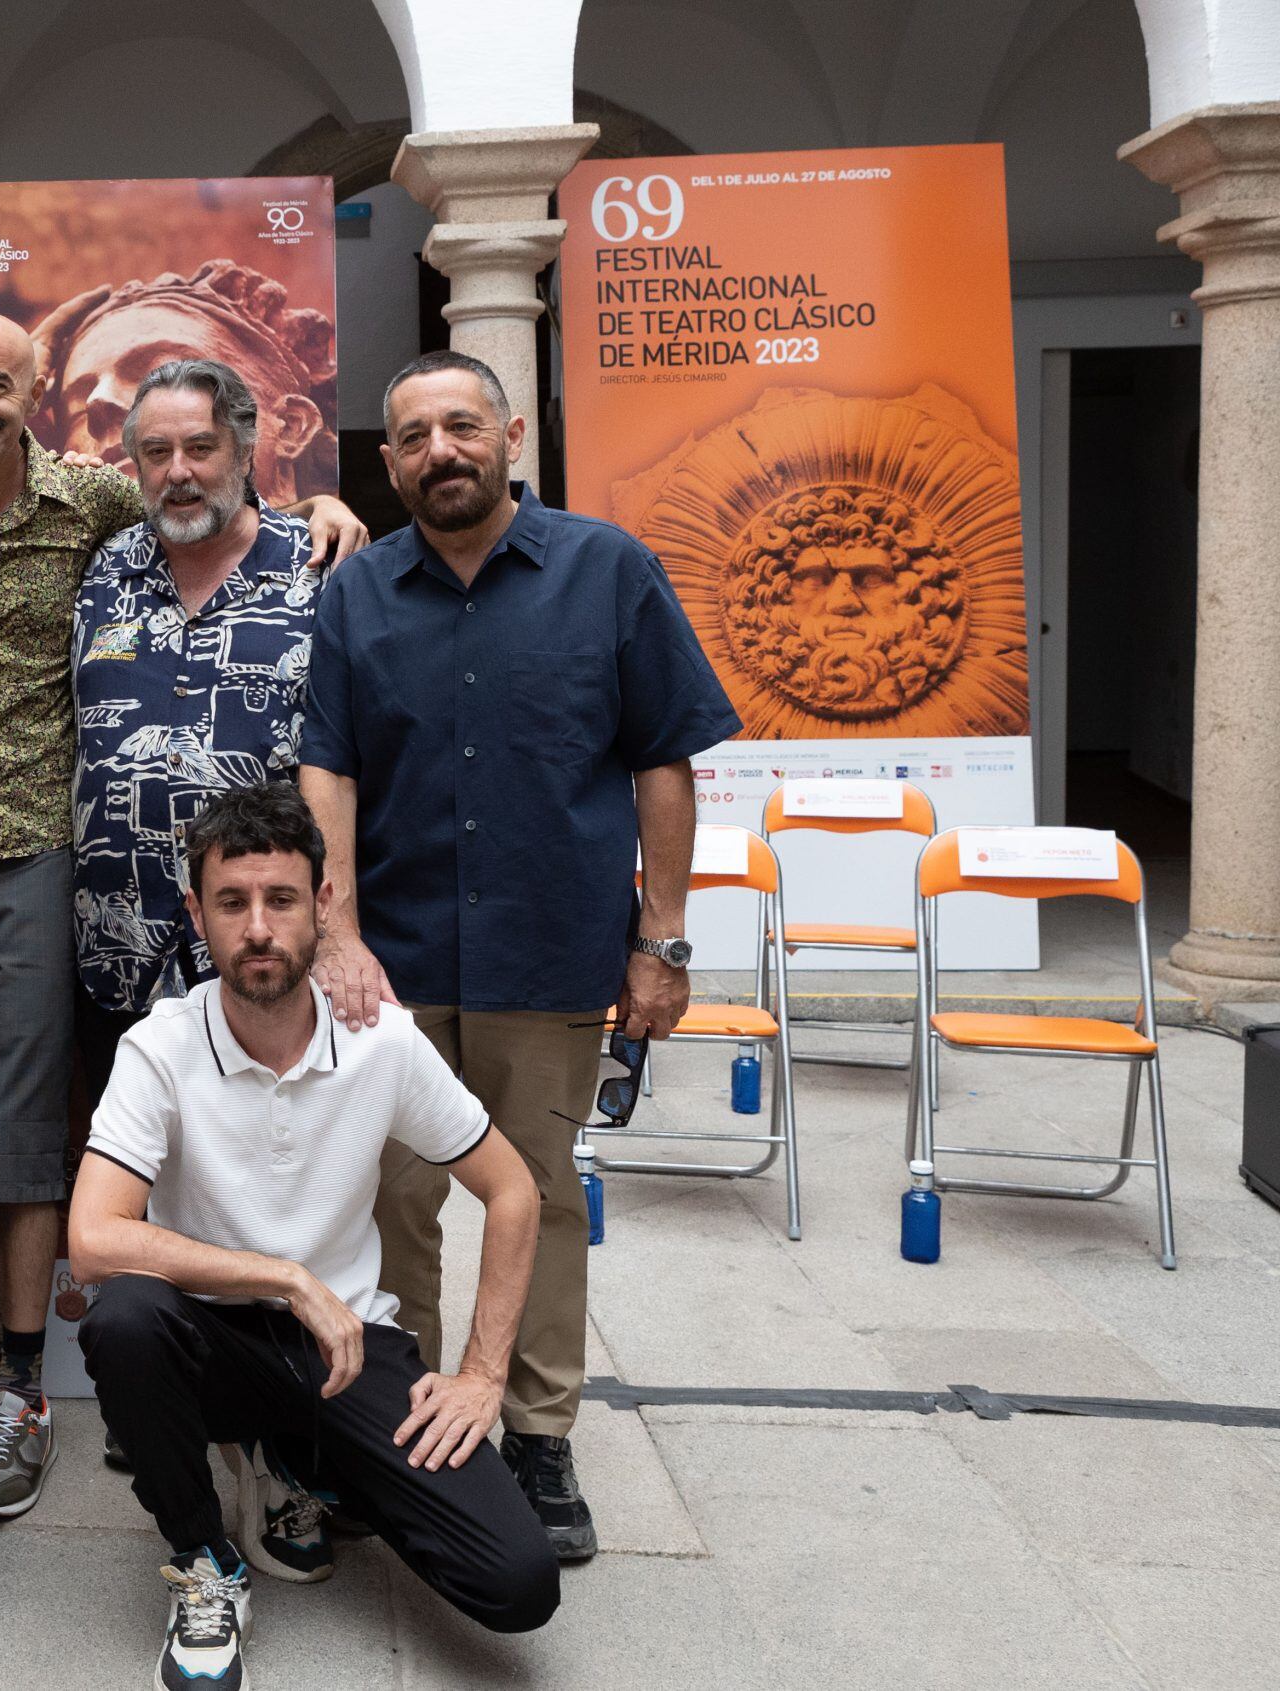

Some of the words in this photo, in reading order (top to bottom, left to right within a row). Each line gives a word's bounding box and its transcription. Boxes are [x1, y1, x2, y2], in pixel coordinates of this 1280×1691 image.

[692, 175, 715, 187] DEL
[717, 175, 724, 186] 1
[725, 175, 742, 186] DE
[744, 173, 780, 185] JULIO
[782, 173, 799, 183] AL
[801, 172, 816, 183] 27
[818, 170, 835, 182] DE
[838, 168, 891, 181] AGOSTO
[267, 207, 304, 231] 90
[591, 174, 685, 243] 69
[596, 245, 722, 272] FESTIVAL
[598, 274, 828, 305] INTERNACIONAL
[599, 312, 634, 336] DE
[640, 308, 747, 335] TEATRO
[754, 299, 876, 332] CLÁSICO
[600, 344, 634, 368] DE
[643, 334, 750, 367] MÉRIDA
[755, 337, 819, 365] 2023
[600, 374, 649, 384] DIRECTOR:
[651, 372, 682, 384] JESÚS
[683, 373, 727, 383] CIMARRO
